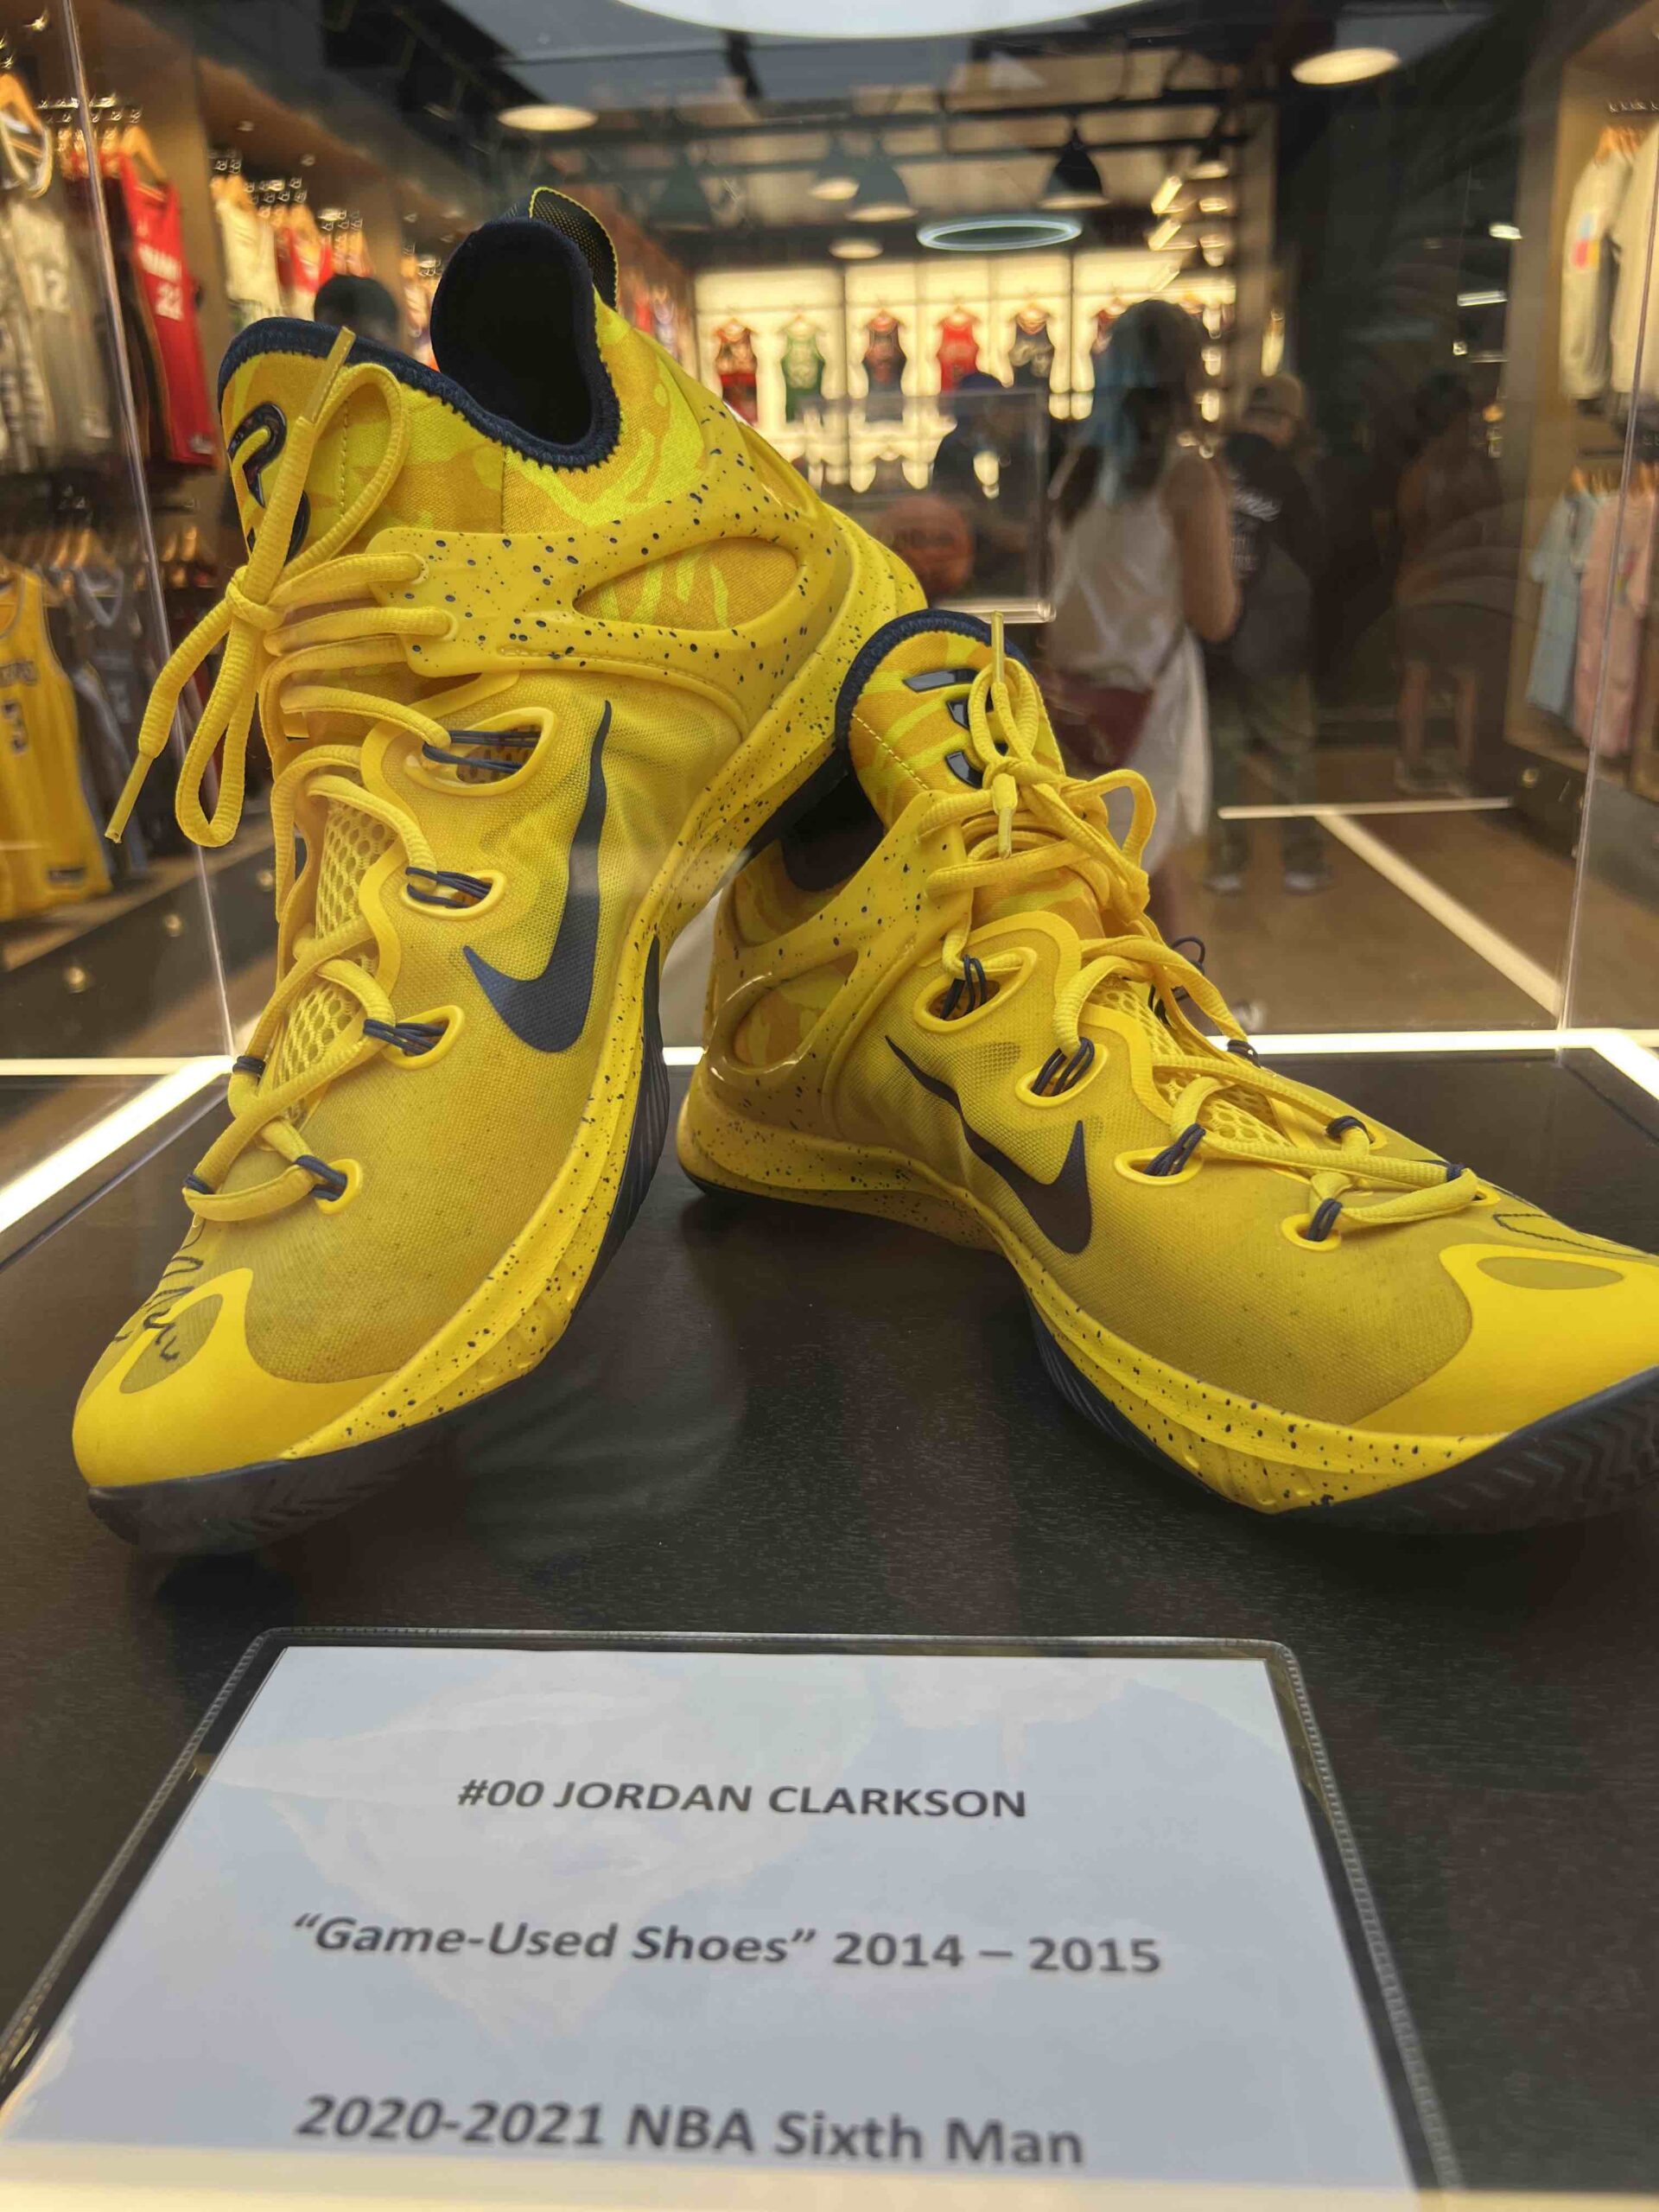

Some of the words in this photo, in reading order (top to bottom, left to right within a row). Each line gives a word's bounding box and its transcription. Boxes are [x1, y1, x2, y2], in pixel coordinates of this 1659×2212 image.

[458, 1778, 544, 1808] #00
[552, 1781, 753, 1814] JORDAN
[768, 1785, 1027, 1819] CLARKSON
[293, 1912, 619, 1959] “Game-Used
[631, 1925, 817, 1965] Shoes”
[831, 1931, 966, 1970] 2014
[1028, 1936, 1162, 1975] 2015
[295, 2094, 604, 2148] 2020-2021
[625, 2103, 757, 2156] NBA
[773, 2110, 925, 2163] Sixth
[944, 2117, 1084, 2167] Man
